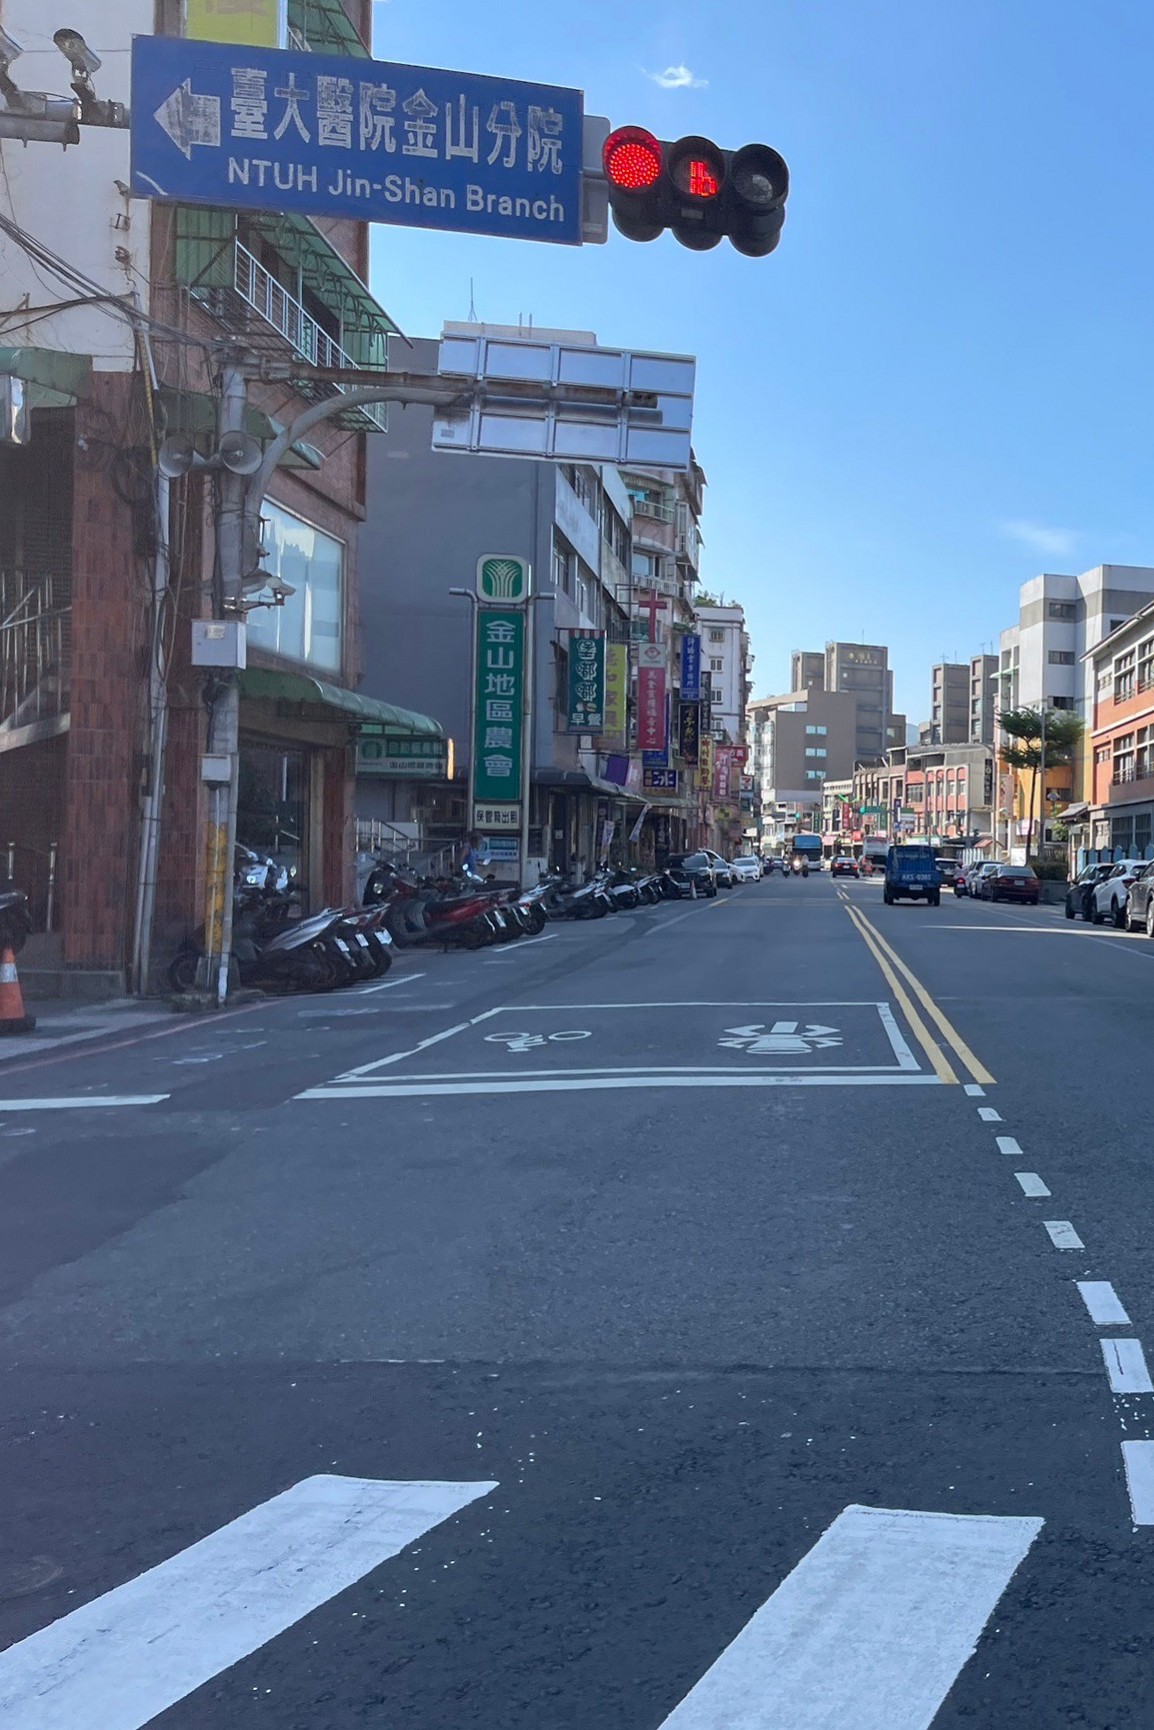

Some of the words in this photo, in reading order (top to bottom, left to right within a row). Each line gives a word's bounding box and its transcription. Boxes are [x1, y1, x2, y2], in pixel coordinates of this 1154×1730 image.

[230, 67, 564, 175] 臺大醫院金山分院
[227, 157, 318, 192] NTUH
[328, 169, 456, 209] Jin-Shan
[466, 185, 566, 222] Branch
[484, 619, 516, 778] 金山地區農會
[571, 712, 602, 726] 早餐
